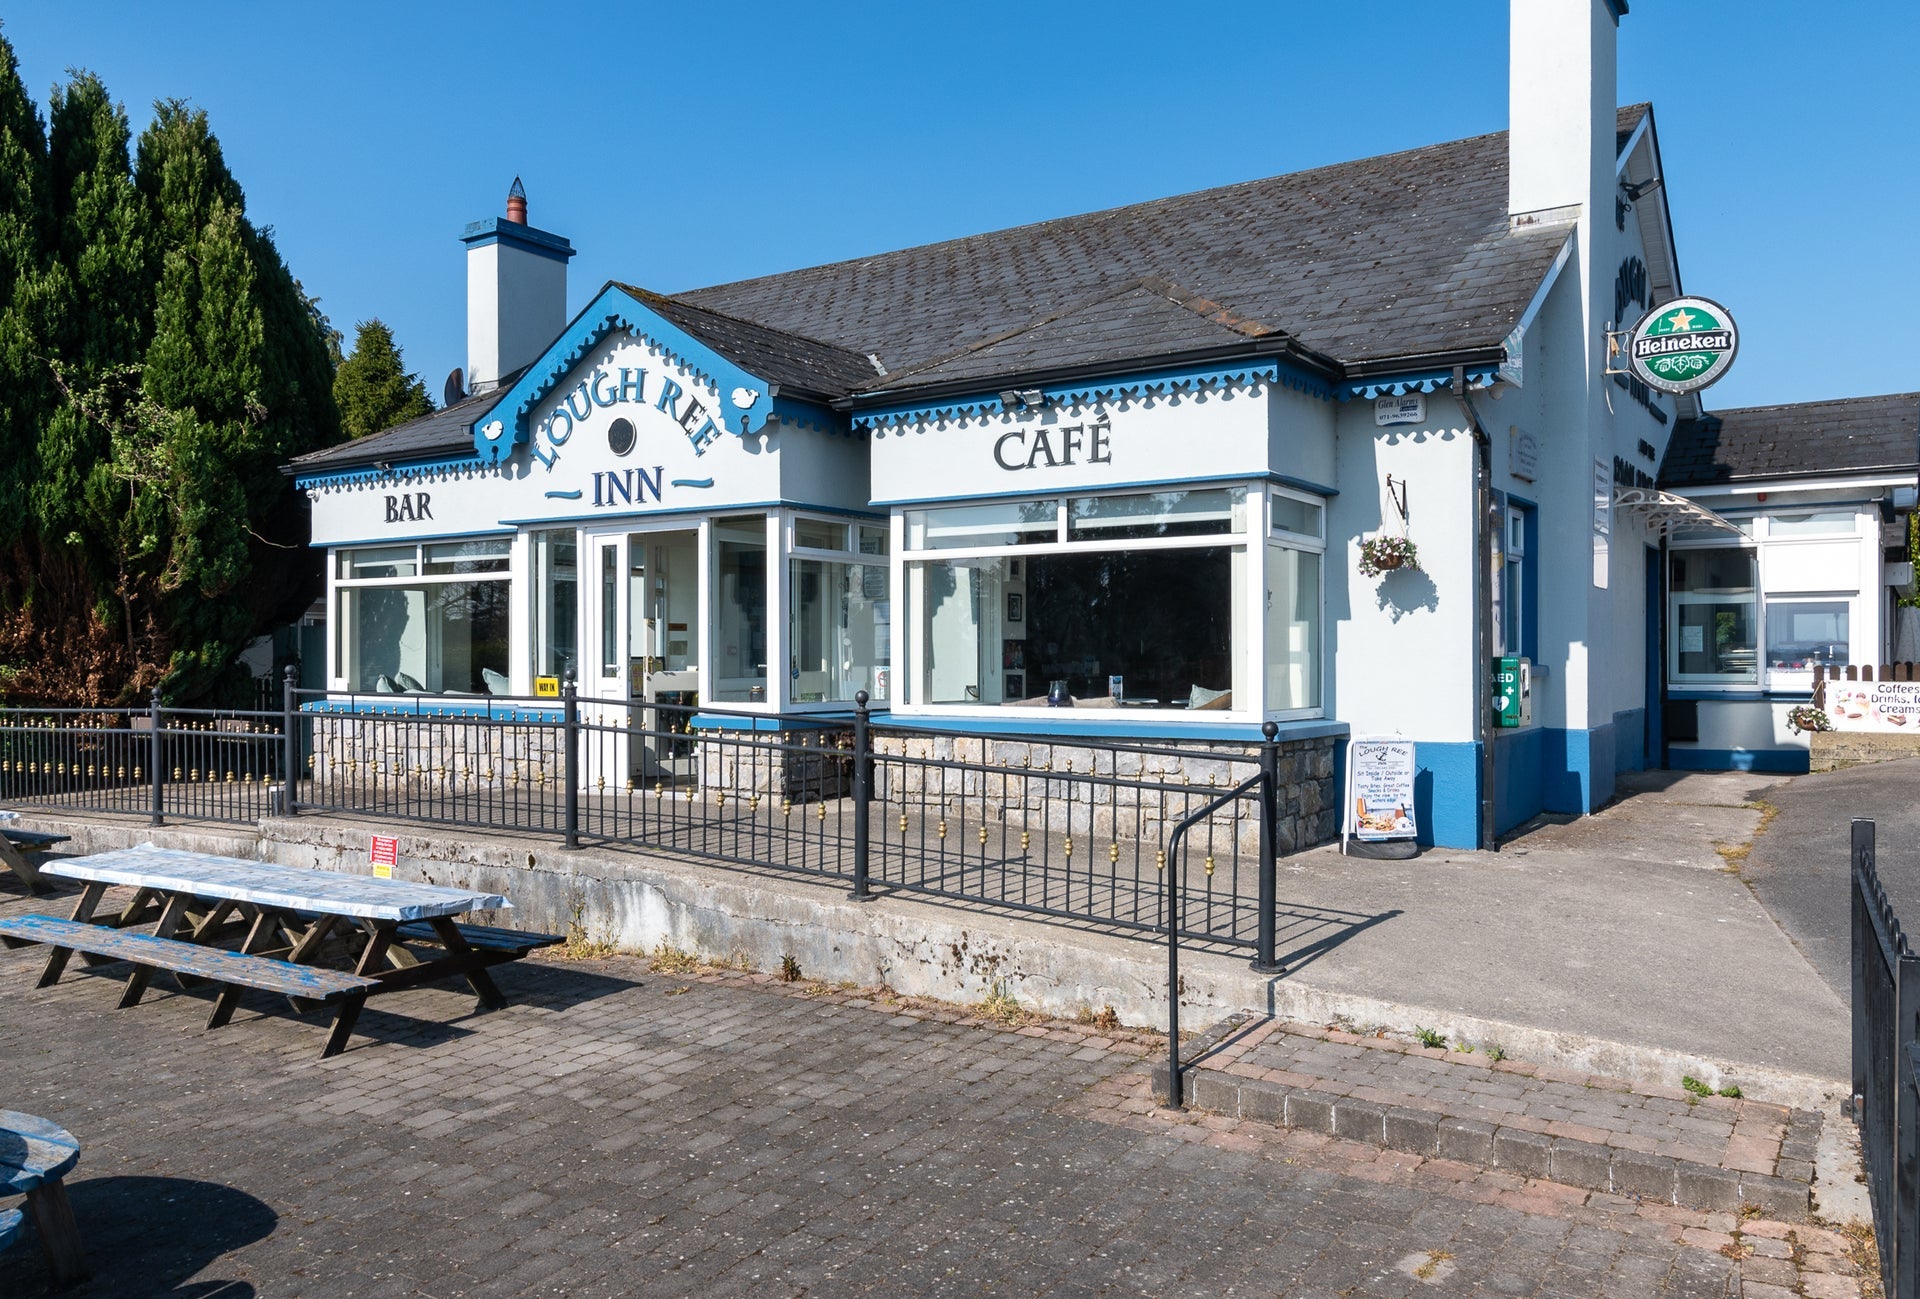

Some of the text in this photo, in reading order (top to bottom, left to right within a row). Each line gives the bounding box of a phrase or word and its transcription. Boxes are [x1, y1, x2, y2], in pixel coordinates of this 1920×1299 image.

[1638, 334, 1727, 355] Heineken
[532, 368, 721, 472] LOUGH REE
[994, 412, 1112, 471] CAFÉ
[591, 465, 664, 507] INN
[384, 492, 434, 524] BAR
[539, 683, 555, 692] WAY IN
[1359, 746, 1408, 756] LOUGH REE
